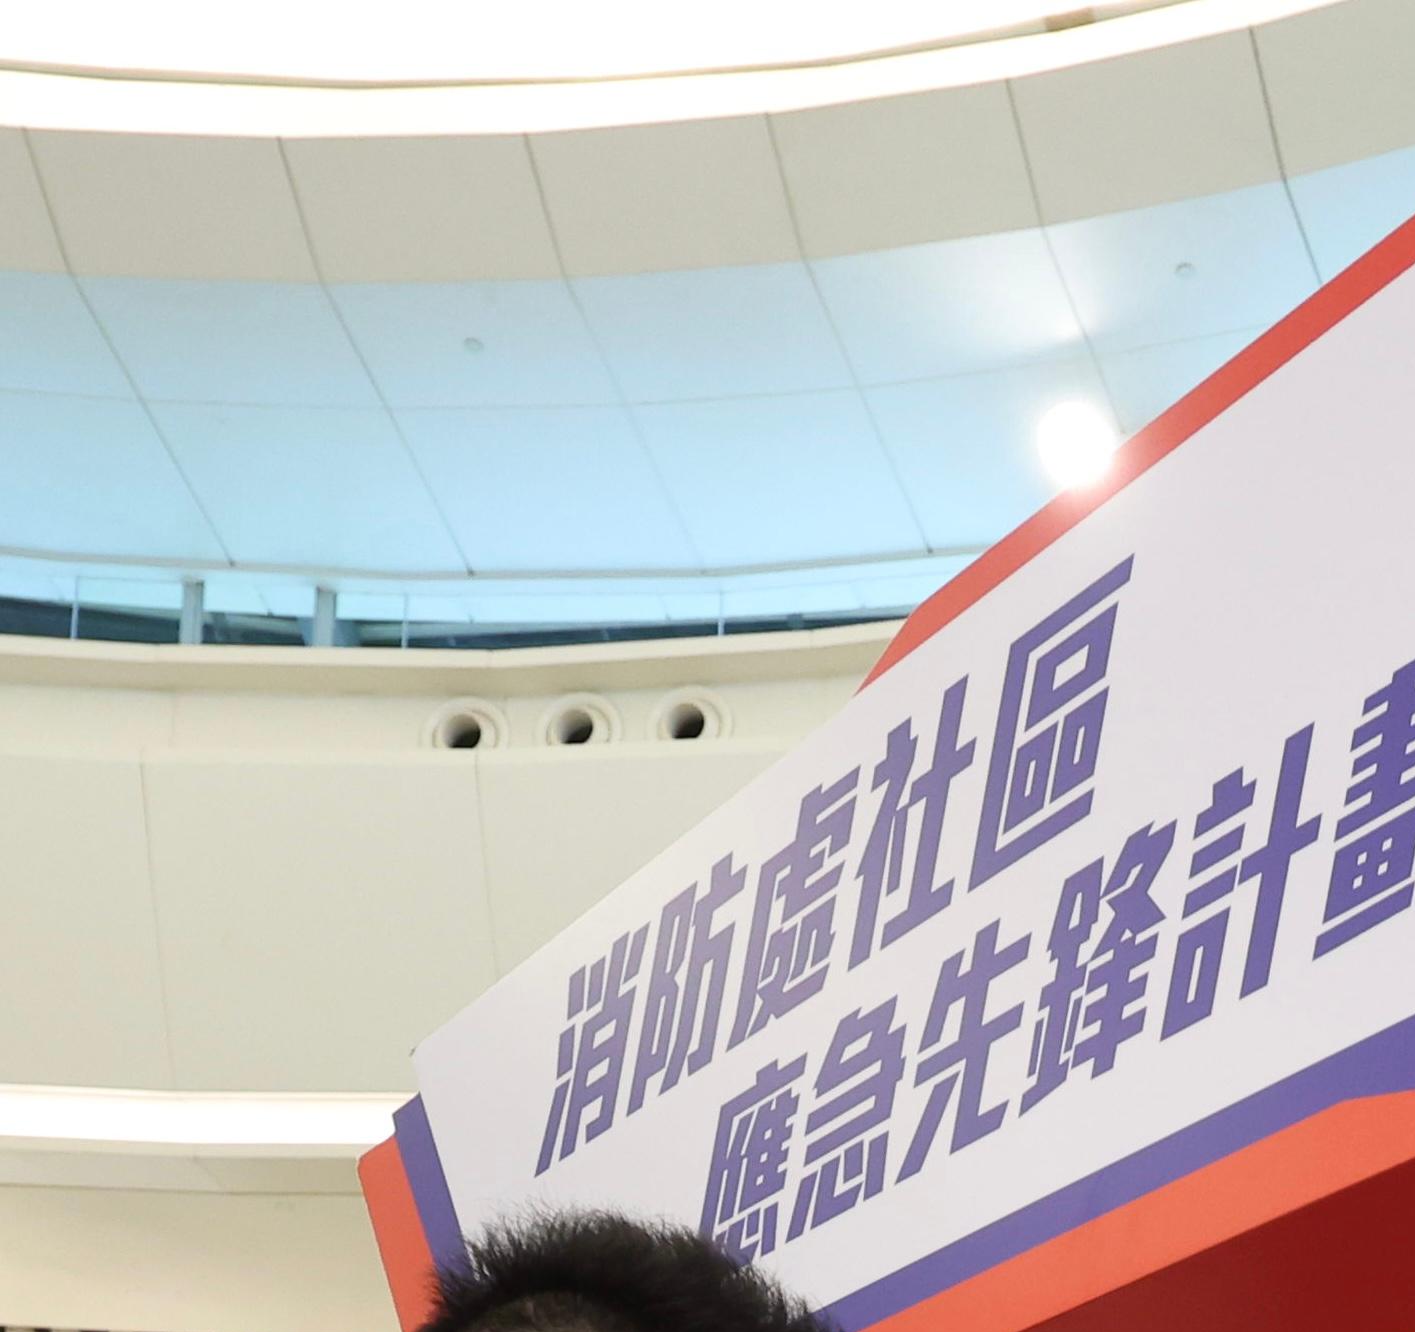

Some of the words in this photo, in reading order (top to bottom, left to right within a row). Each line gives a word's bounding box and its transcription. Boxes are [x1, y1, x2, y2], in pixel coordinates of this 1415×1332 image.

[535, 554, 1135, 1177] 消防處社區
